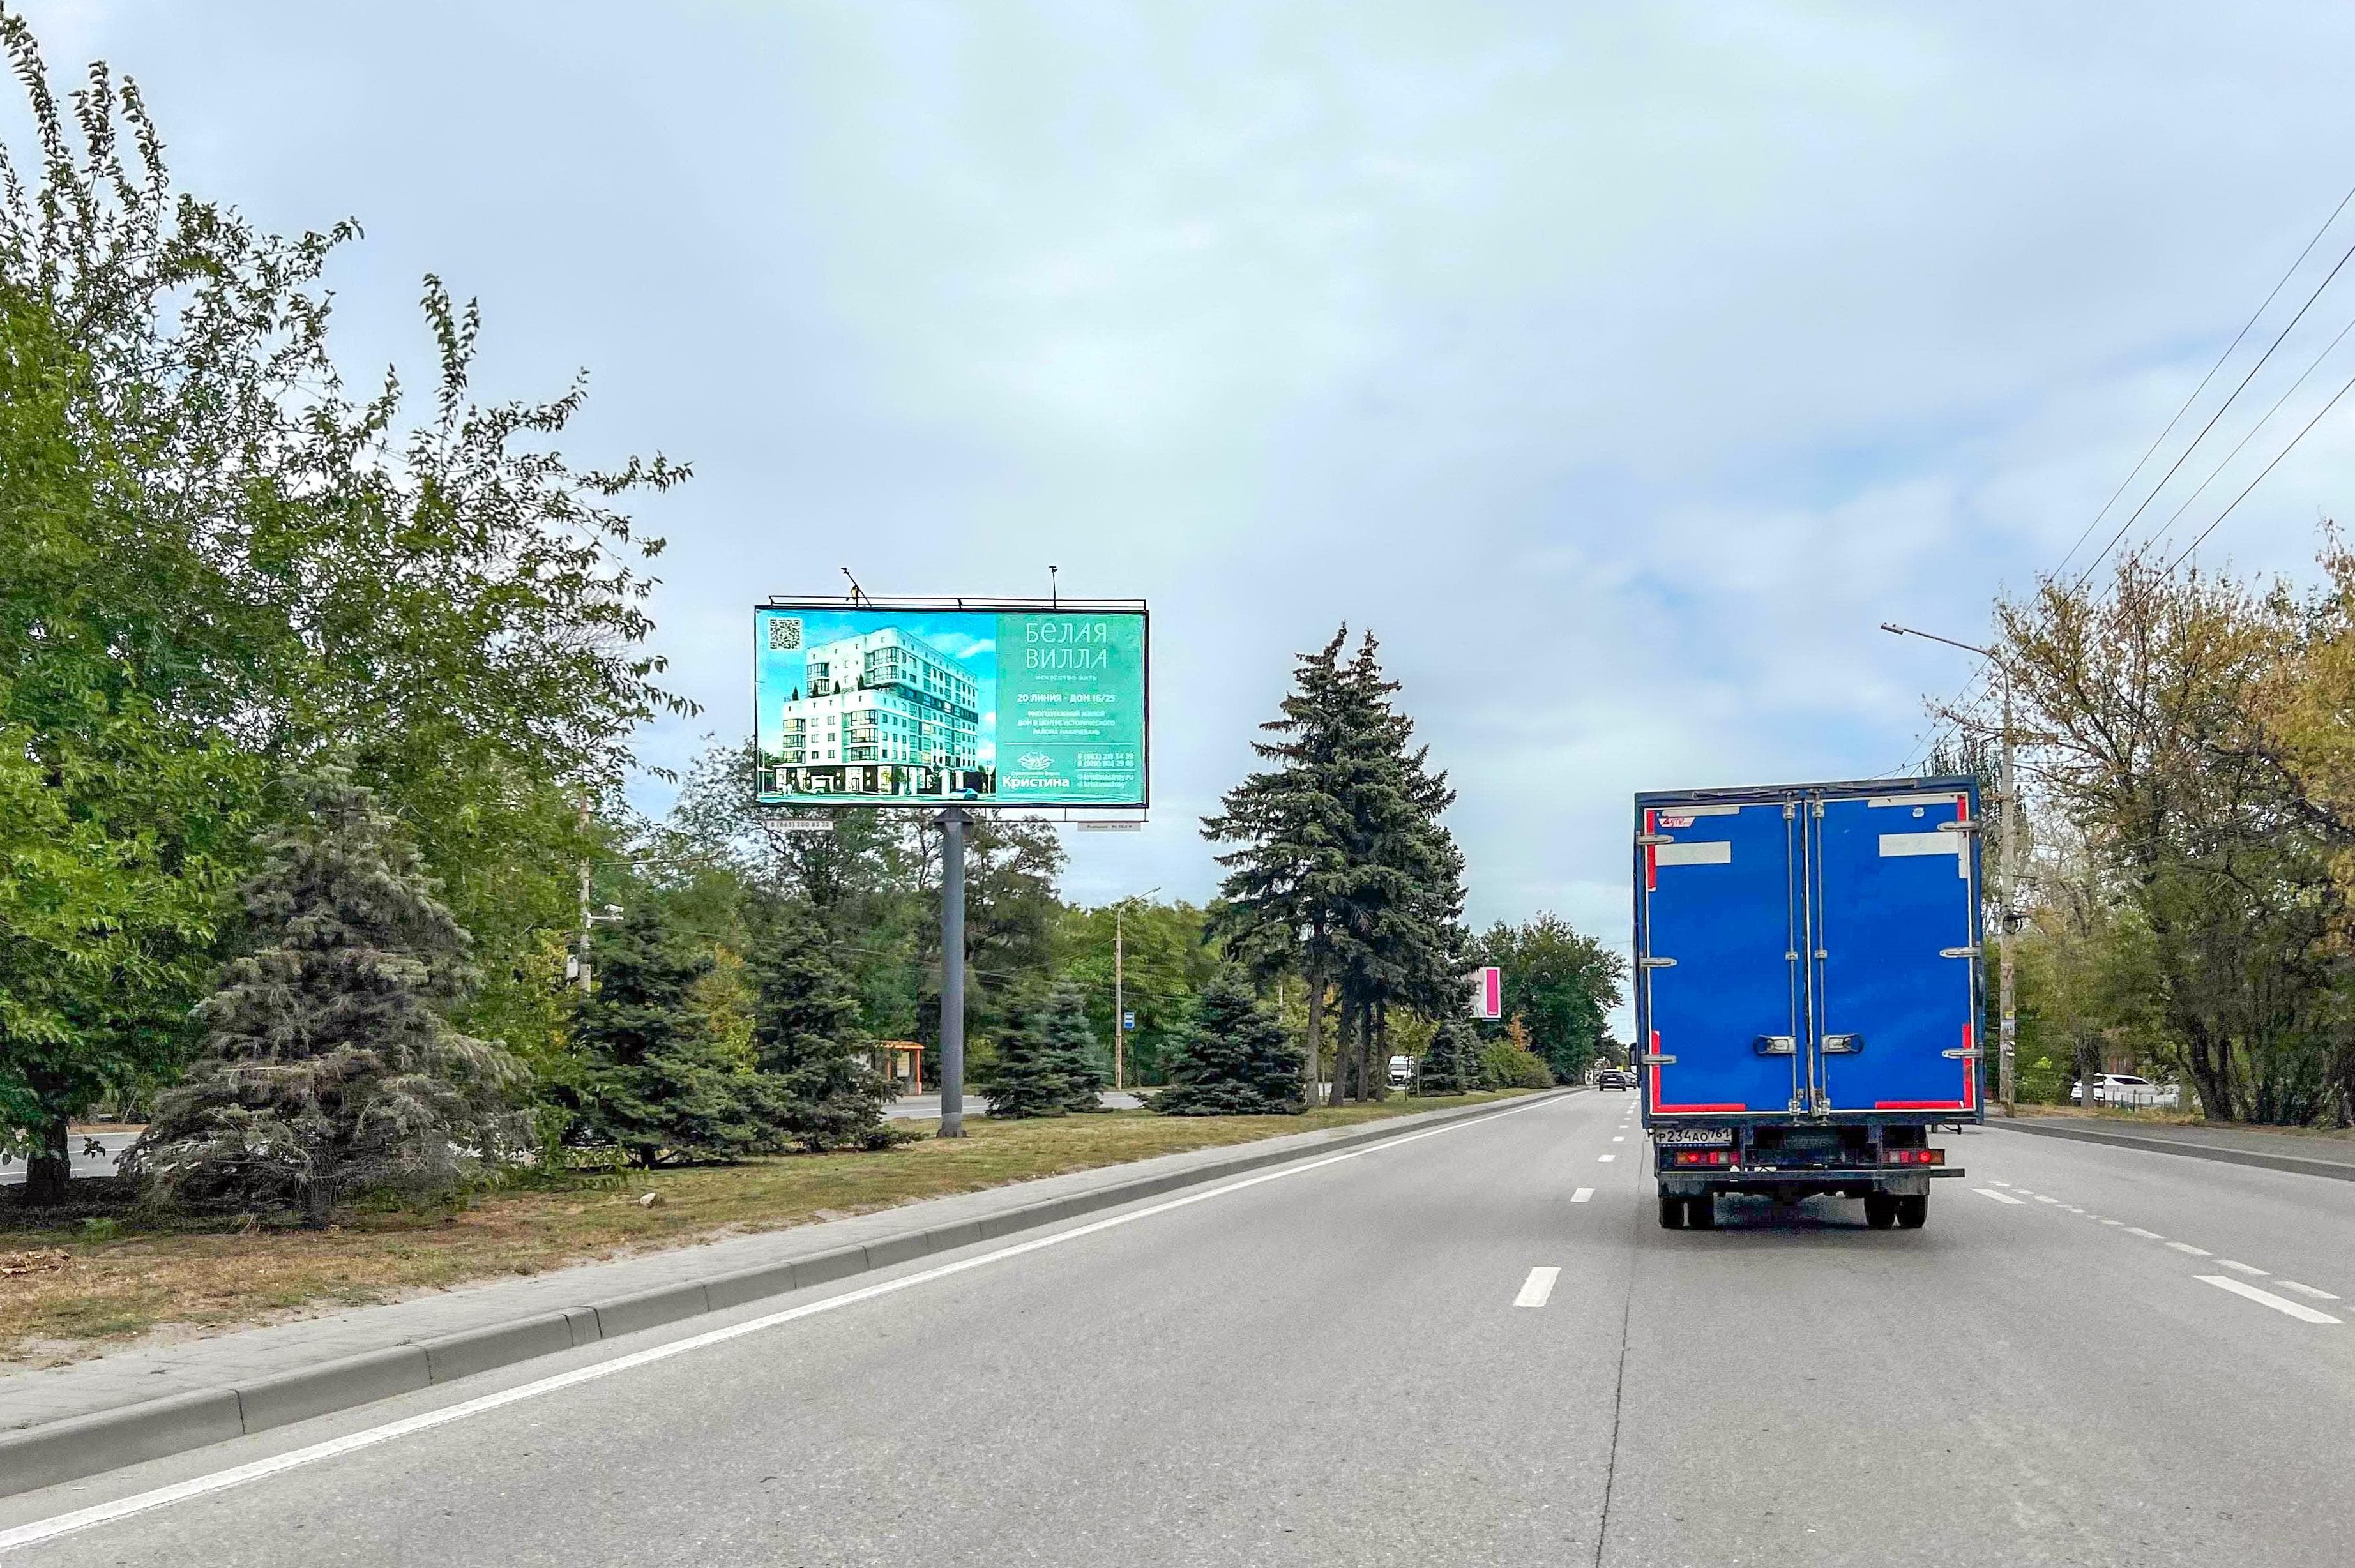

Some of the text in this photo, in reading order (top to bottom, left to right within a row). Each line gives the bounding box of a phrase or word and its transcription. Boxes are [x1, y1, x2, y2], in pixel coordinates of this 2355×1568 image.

[1026, 648, 1107, 669] ВИЛЛА
[1017, 693, 1029, 703] 20
[1030, 693, 1062, 703] ЛИНИЯ
[1069, 693, 1090, 704] ДОМ
[1002, 776, 1070, 789] Кристина
